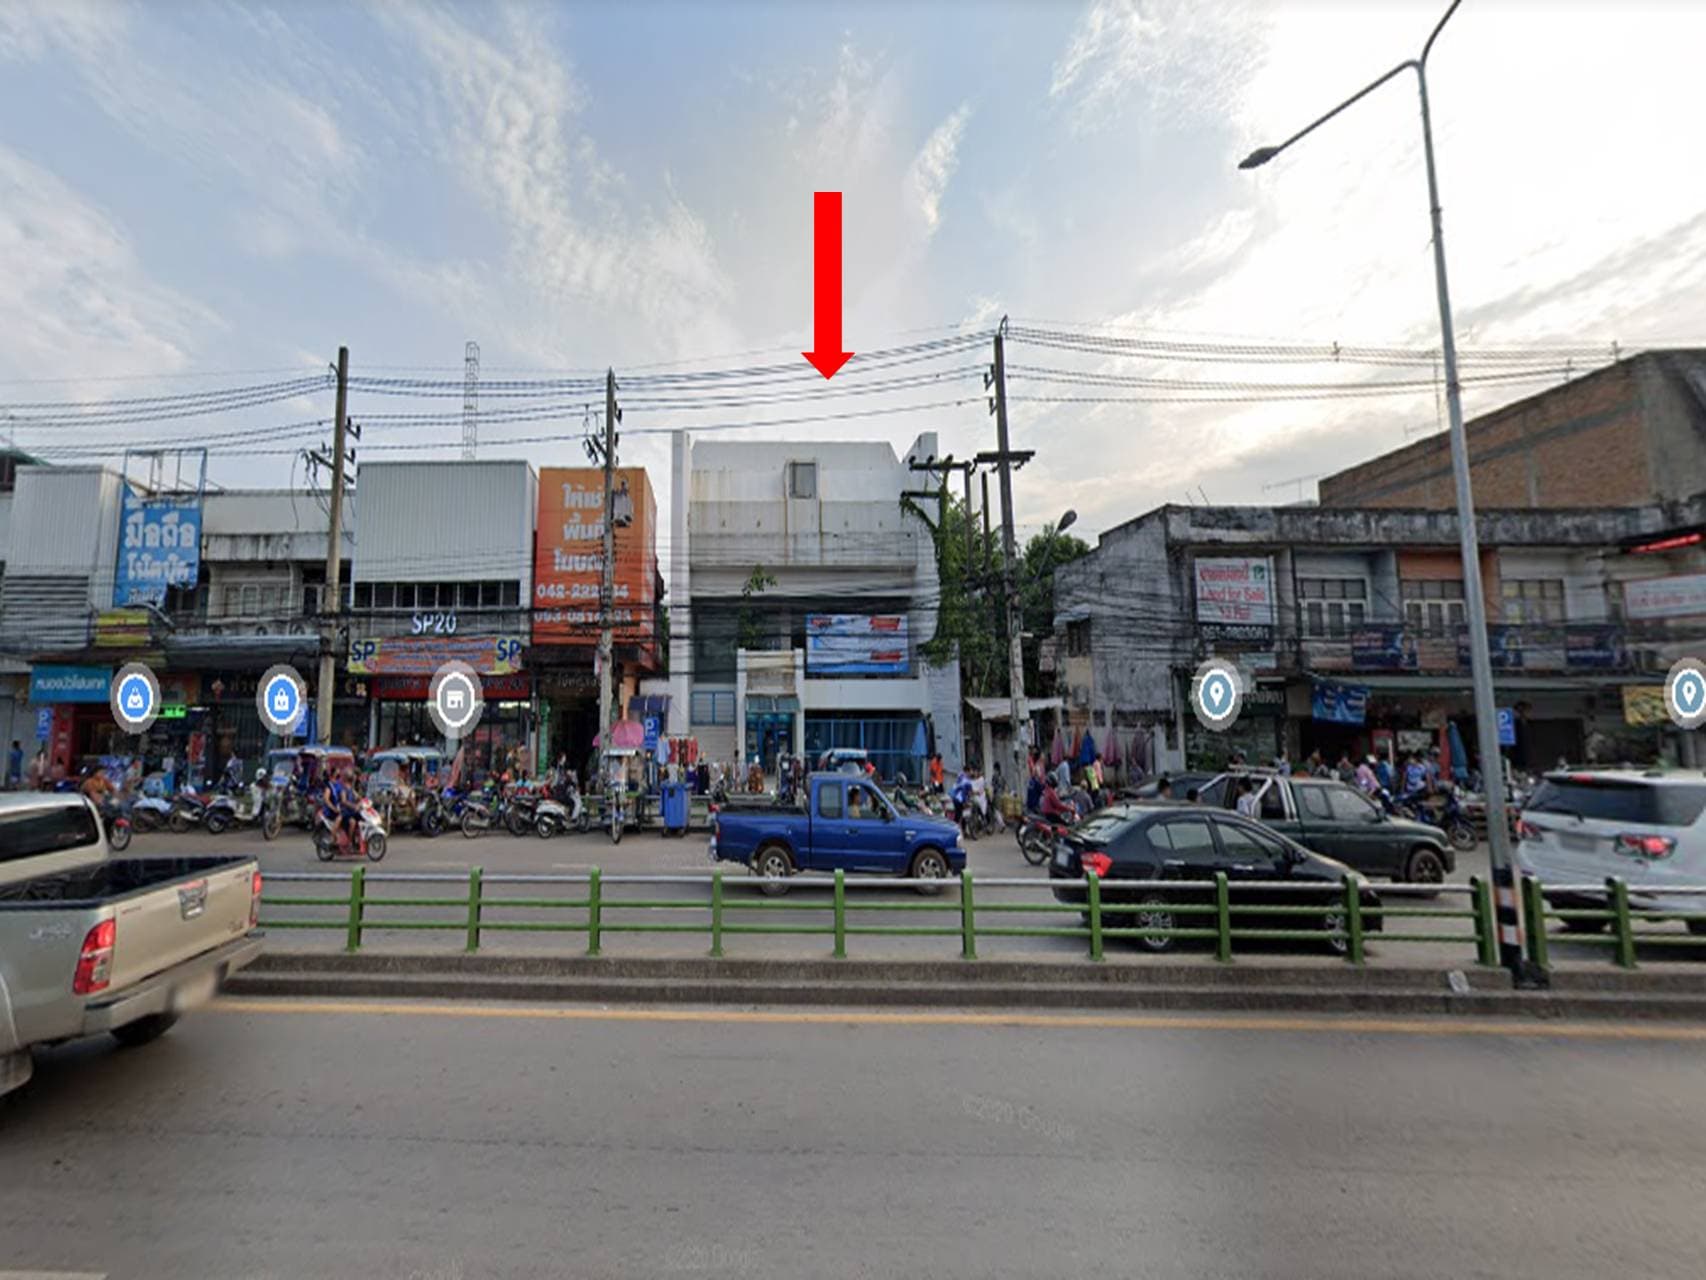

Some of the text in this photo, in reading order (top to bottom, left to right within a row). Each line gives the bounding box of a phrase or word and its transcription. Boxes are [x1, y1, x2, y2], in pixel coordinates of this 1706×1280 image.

[561, 482, 612, 509] ให้เช่
[124, 510, 196, 548] มือถือ
[553, 547, 609, 572] โฆษณ
[411, 612, 457, 634] SP20
[351, 640, 376, 662] SP
[497, 639, 521, 662] SP
[645, 718, 655, 737] P
